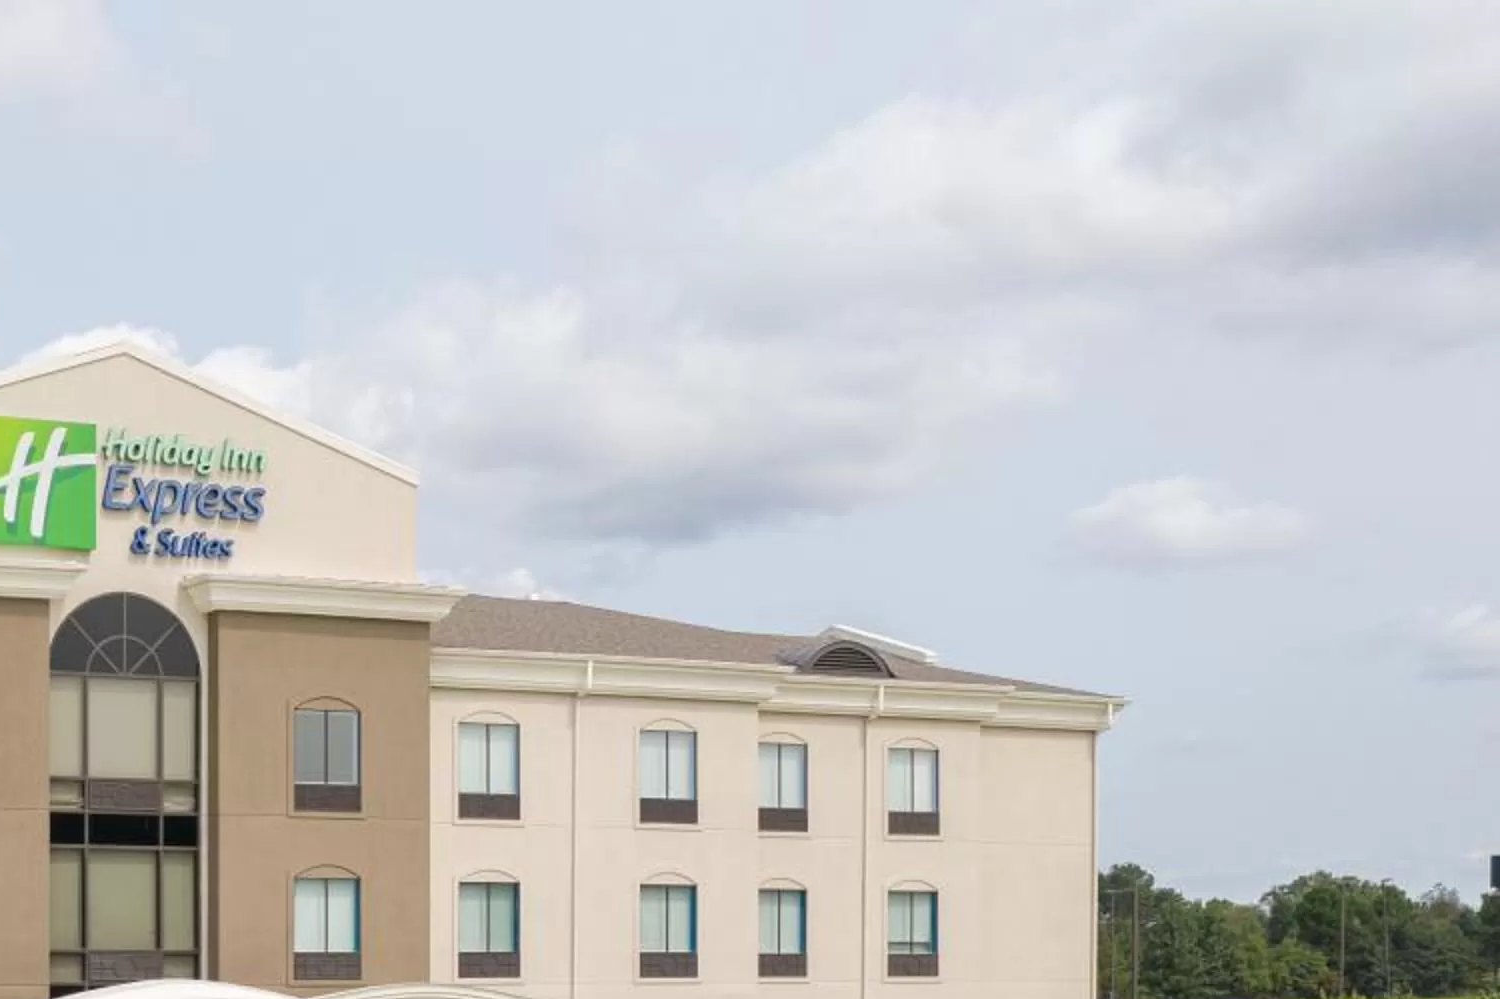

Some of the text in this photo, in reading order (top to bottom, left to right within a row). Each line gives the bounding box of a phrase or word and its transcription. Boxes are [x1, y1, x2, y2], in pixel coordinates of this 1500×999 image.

[101, 428, 267, 476] Holiday Inn
[102, 463, 267, 526] Express
[130, 525, 235, 560] & Suites
